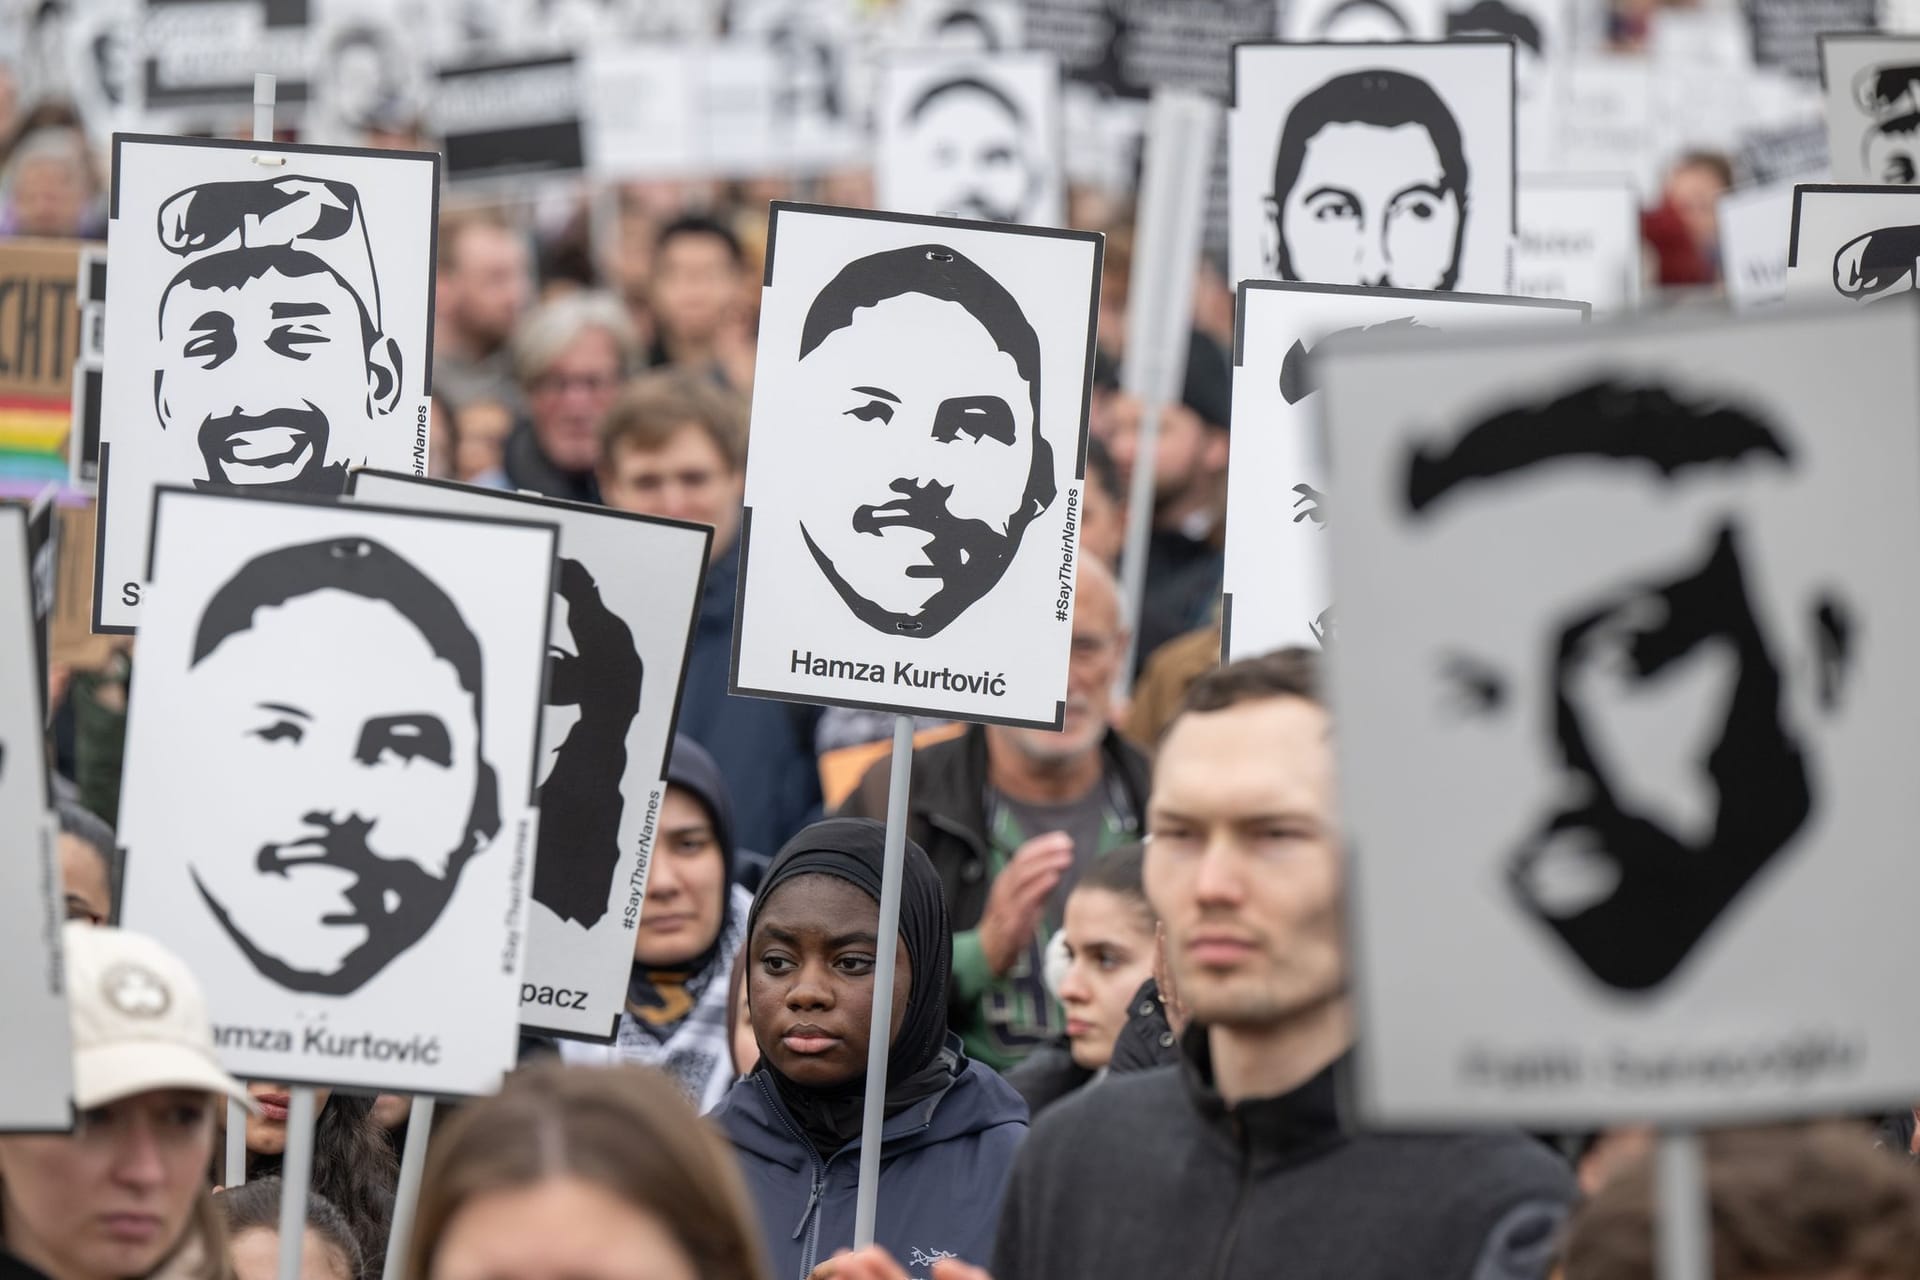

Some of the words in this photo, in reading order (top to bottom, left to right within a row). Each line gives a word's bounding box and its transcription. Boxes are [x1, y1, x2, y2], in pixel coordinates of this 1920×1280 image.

[1056, 488, 1078, 622] #SayTheirNames
[122, 582, 142, 606] S
[791, 650, 885, 683] Hamza
[893, 661, 1007, 697] Kurtović
[622, 790, 661, 931] #SayTheirNames
[302, 1025, 441, 1066] Kurtović
